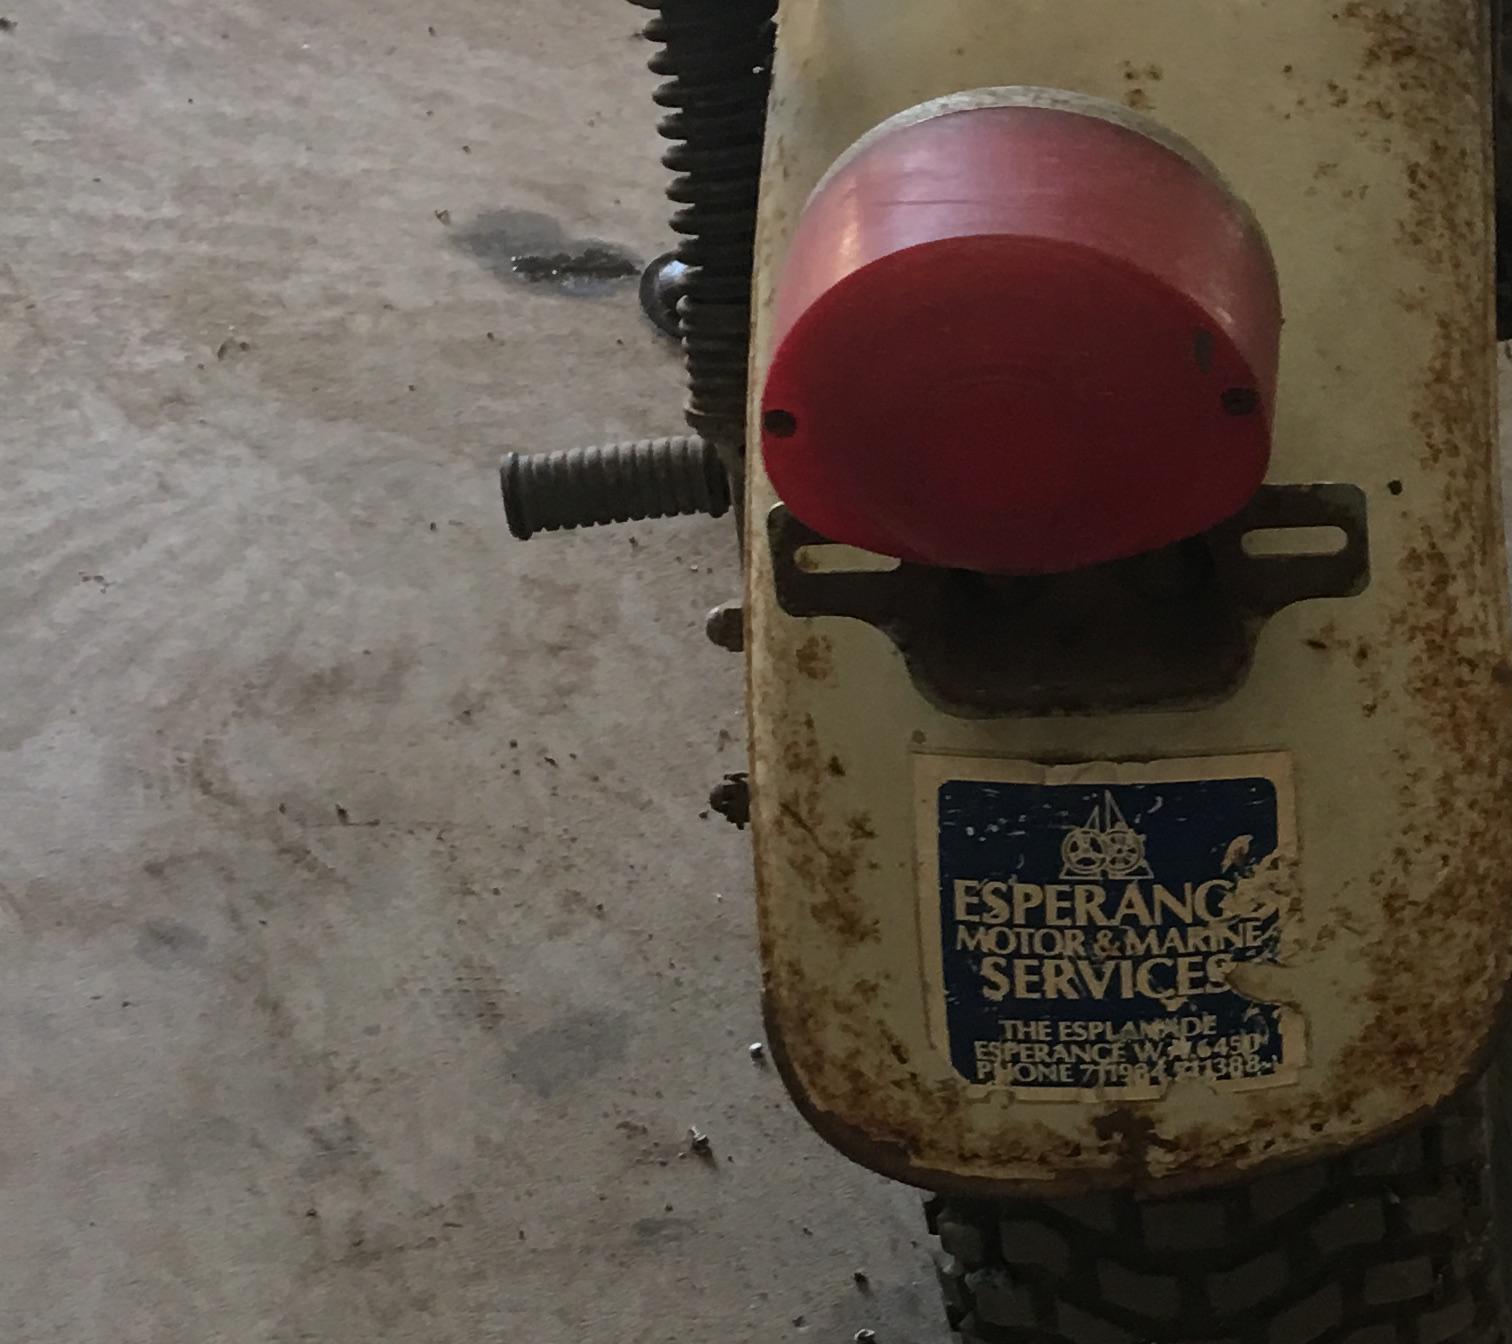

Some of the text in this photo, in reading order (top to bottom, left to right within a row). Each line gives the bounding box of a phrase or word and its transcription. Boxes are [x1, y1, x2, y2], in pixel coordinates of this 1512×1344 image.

[952, 877, 1244, 927] ESPERANC
[956, 922, 1263, 957] MOTOR & MARINE
[979, 954, 1236, 1002] SERVICES
[997, 1019, 1053, 1041] THE
[973, 1039, 1127, 1063] ESPERANCE
[975, 1060, 1075, 1083] PHONE
